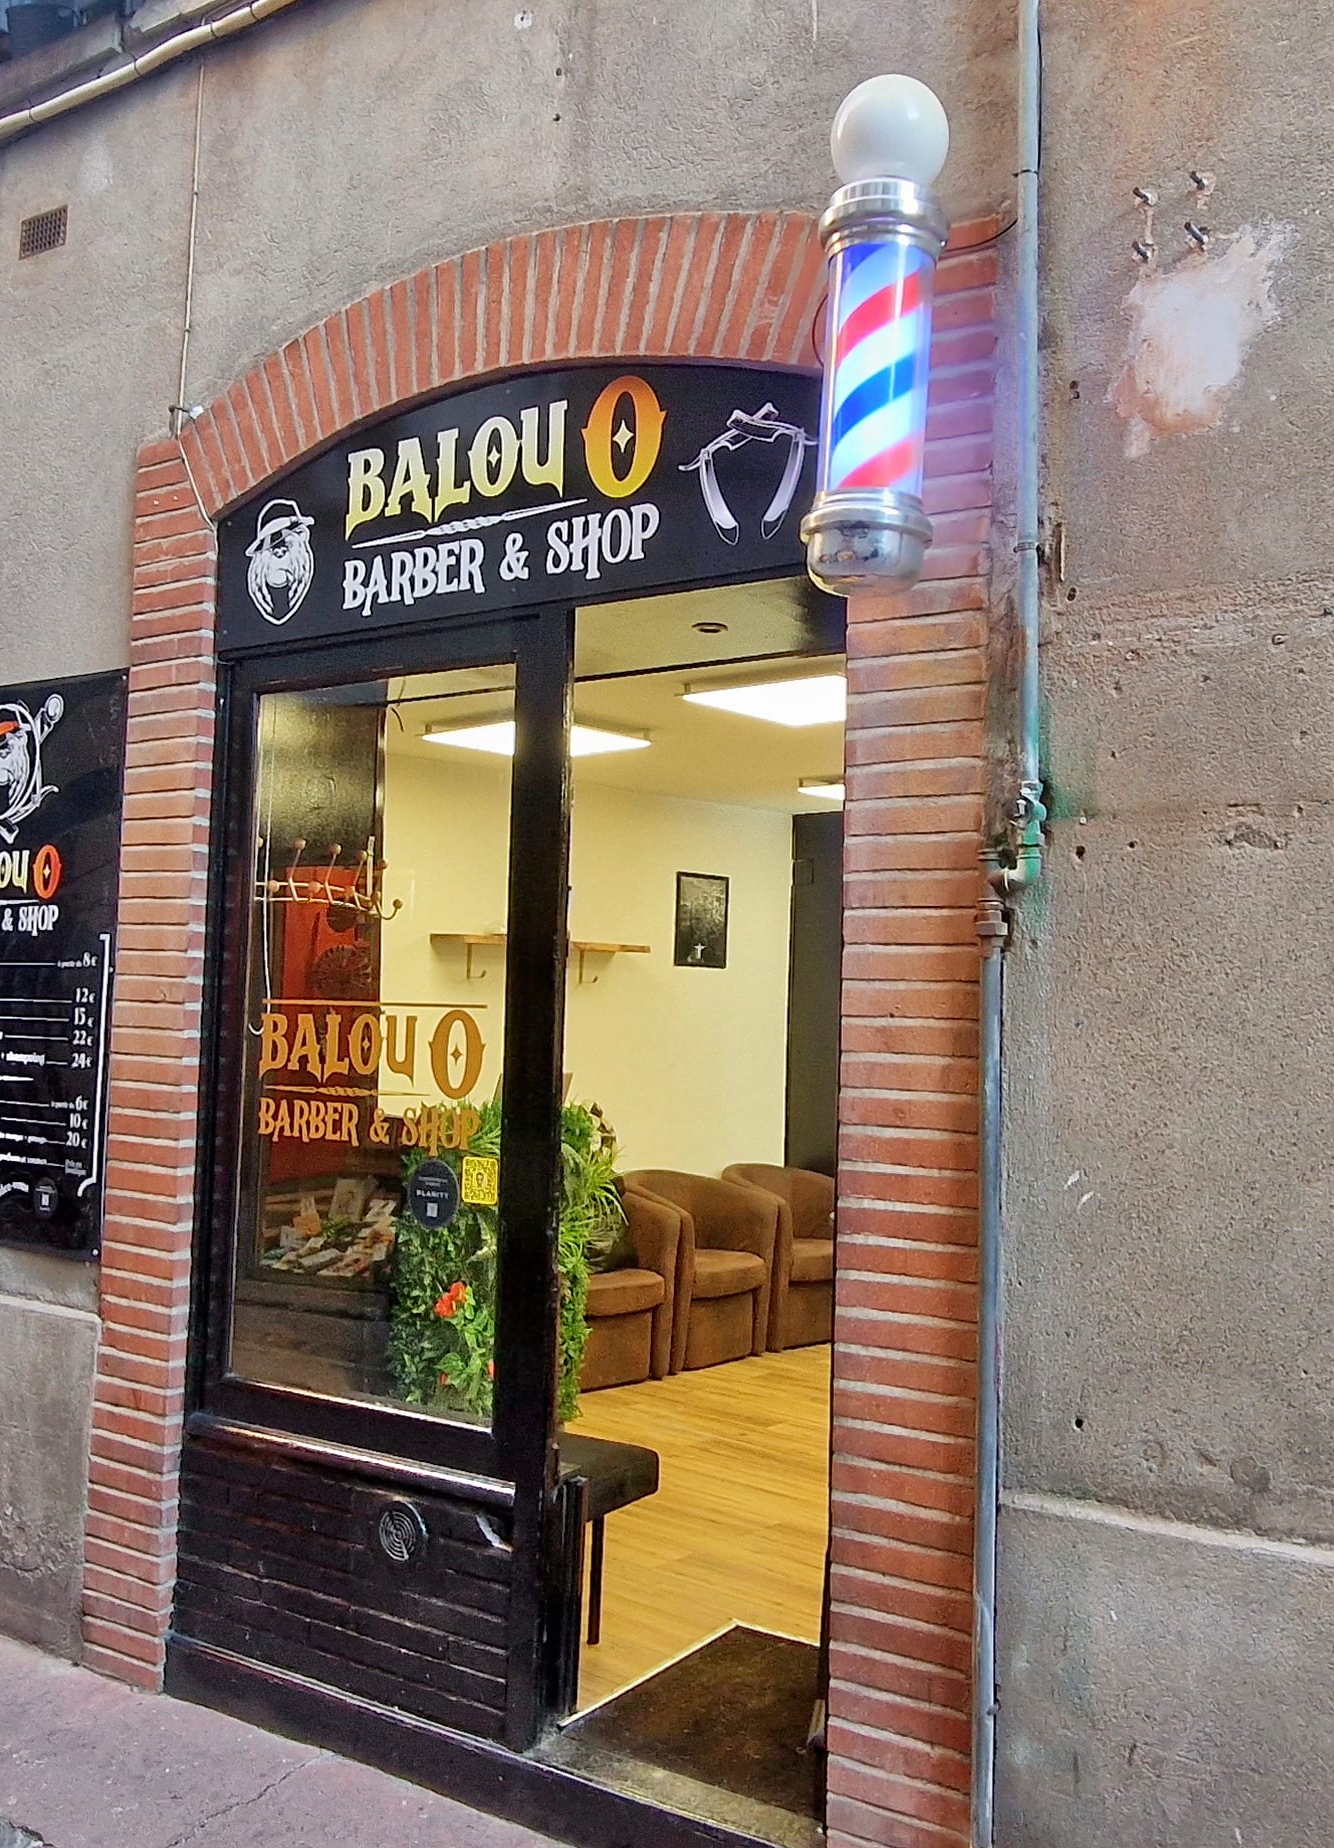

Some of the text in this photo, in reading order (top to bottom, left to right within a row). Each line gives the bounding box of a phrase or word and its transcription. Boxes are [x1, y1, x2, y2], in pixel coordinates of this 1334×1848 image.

[345, 374, 666, 541] BALOU O
[342, 503, 660, 616] BARBER & SHOP
[32, 844, 62, 900] O
[1, 906, 14, 932] &
[18, 905, 59, 936] SHOP
[258, 1009, 486, 1100] BALOU O
[257, 1097, 481, 1157] BARBER & SHOP
